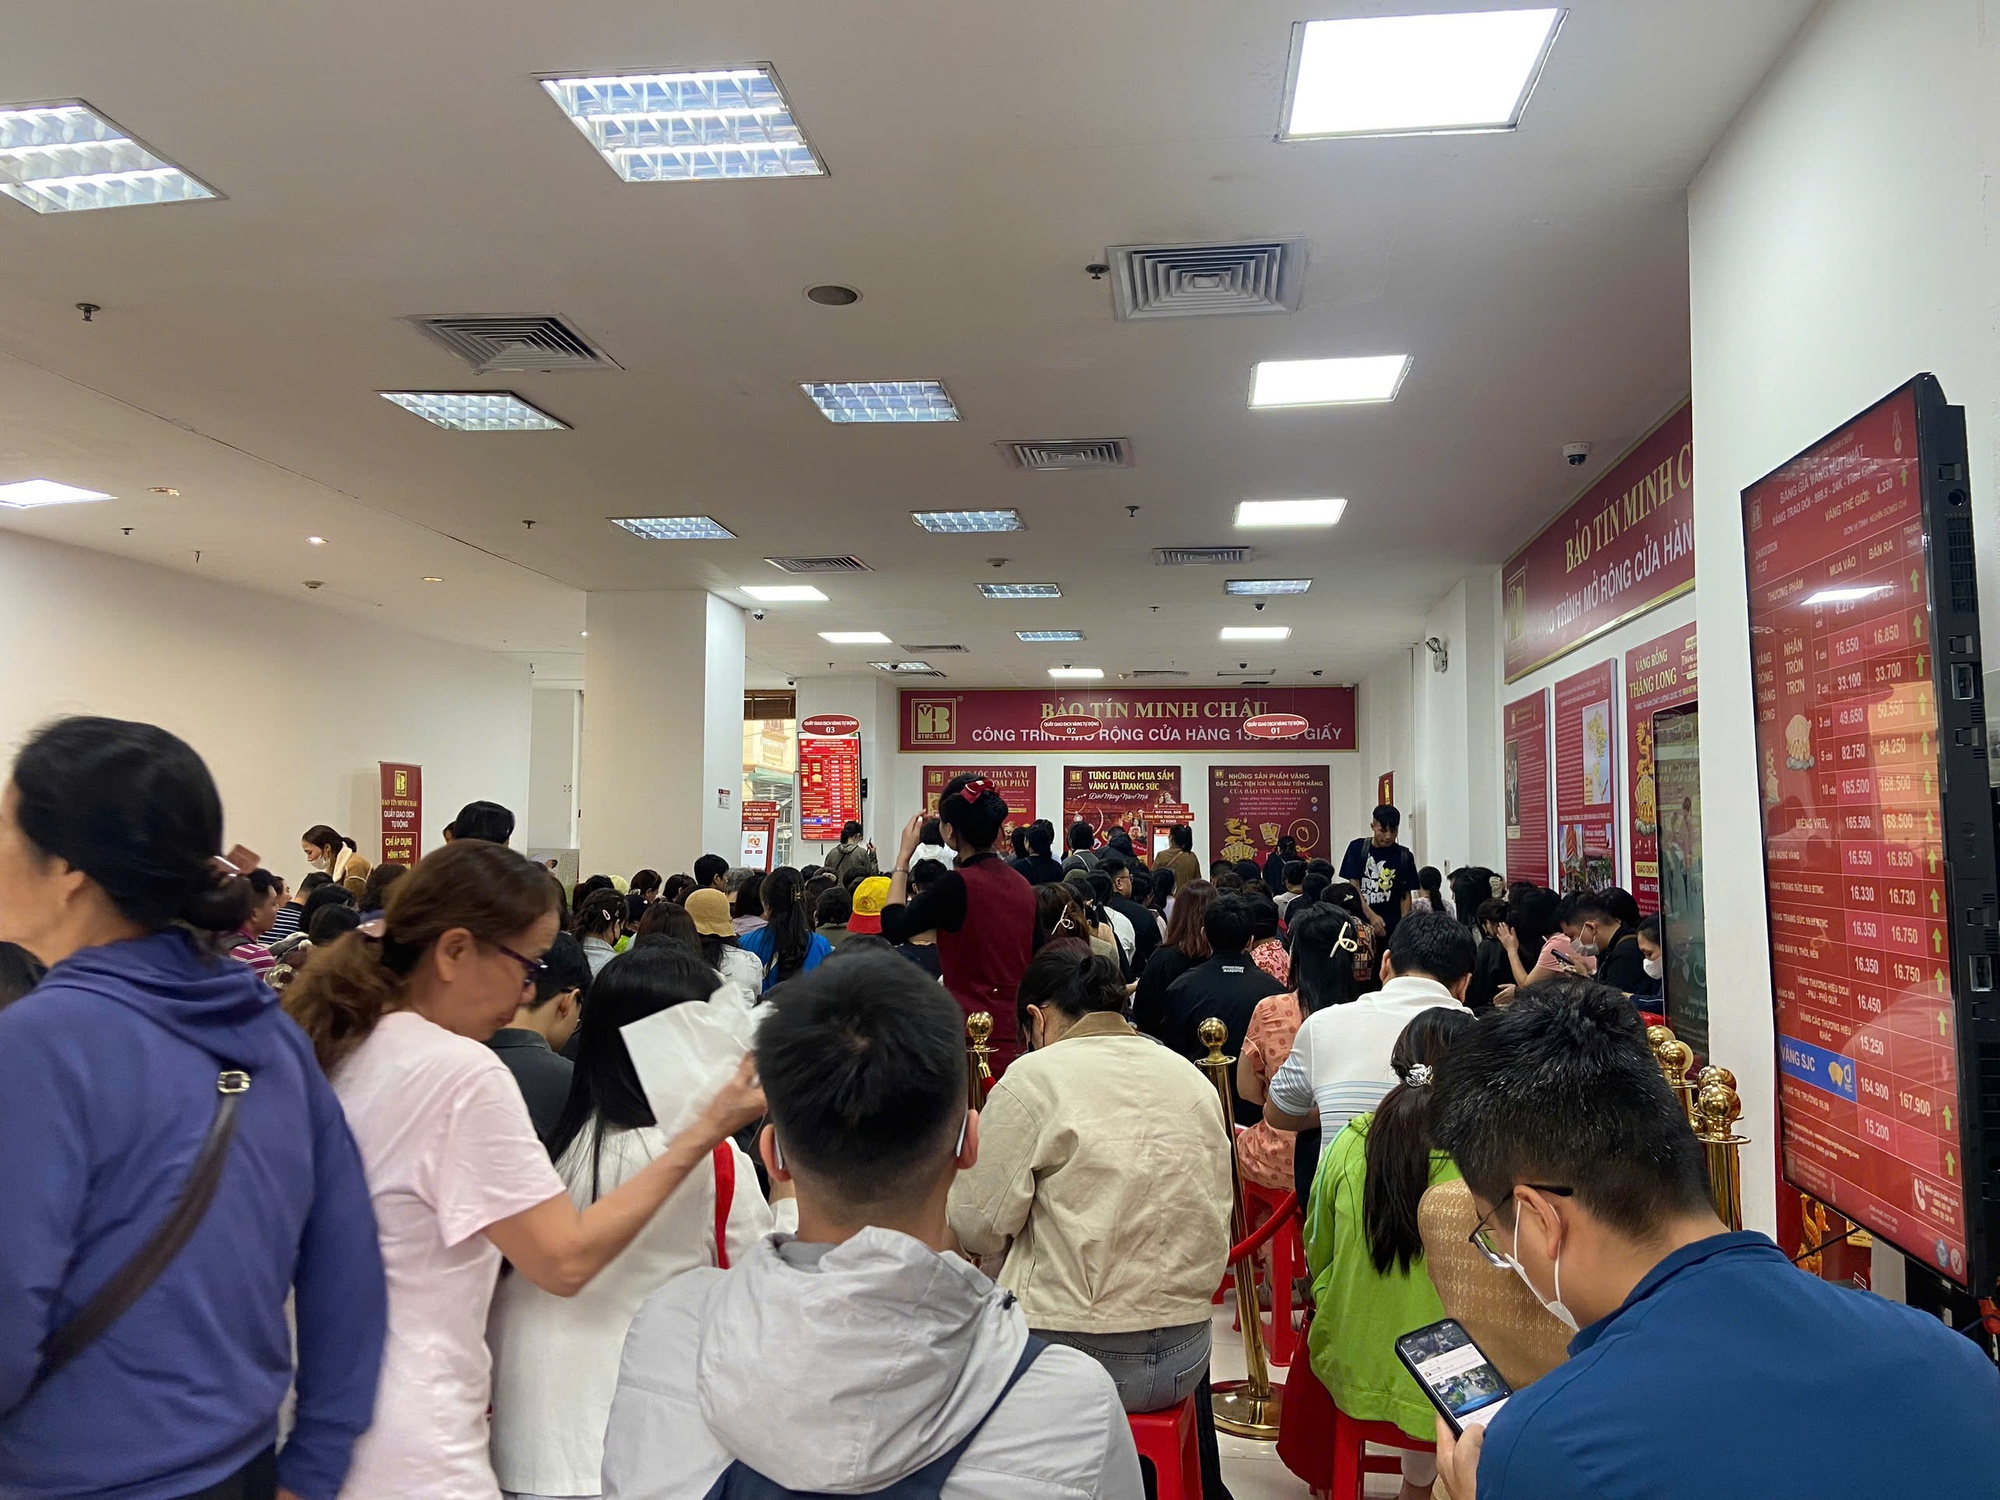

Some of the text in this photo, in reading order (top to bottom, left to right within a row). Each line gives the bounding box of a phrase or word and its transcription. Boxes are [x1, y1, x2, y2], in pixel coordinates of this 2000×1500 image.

[1779, 483, 1798, 504] BẢNG
[1797, 475, 1810, 493] GIÁ
[1825, 505, 1842, 522] VÀNG
[1842, 497, 1855, 515] THẾ
[1876, 478, 1893, 496] 4.330
[1565, 456, 1674, 573] BẢO TÍN MINH
[1786, 504, 1801, 521] TRAO
[1868, 540, 1893, 560] BÁN RA
[1583, 570, 1599, 612] MỞ
[1600, 559, 1632, 604] RỘNG
[1634, 534, 1660, 583] CỬA
[1663, 519, 1696, 566] HÀN
[1829, 556, 1857, 577] MUA VÀO
[1873, 625, 1899, 645] 16.850
[1783, 638, 1803, 656] NHẪN
[1835, 636, 1859, 656] 16.550
[1635, 646, 1668, 672] VÀNG RỒNG
[1815, 651, 1819, 660] 1
[1785, 657, 1804, 675] TRÒN
[1875, 662, 1902, 682] 33.700
[1629, 674, 1654, 699] THĂNG
[1655, 667, 1677, 690] LONG
[1786, 678, 1805, 695] TRƠN
[1817, 684, 1821, 694] 2
[1837, 671, 1862, 691] 33.100
[1041, 697, 1269, 719] BẢO TÍN MINH CHÂU
[1760, 708, 1776, 722] LONG
[1839, 708, 1864, 726] 49.650
[1877, 700, 1904, 719] 50.550
[825, 726, 835, 734] 03
[1066, 727, 1076, 735] 02
[1271, 727, 1280, 735] 01
[1819, 717, 1823, 727] 3
[971, 722, 1343, 744] CÔNG RỘNG CỬA HÀNG GIẤY
[1841, 744, 1866, 760] 82.750
[1879, 737, 1906, 755] 84.250
[1820, 751, 1825, 761] 5
[1015, 770, 1028, 778] TÀI
[1137, 771, 1155, 780] MUA
[1156, 768, 1175, 780] SẮM
[1228, 772, 1253, 780] NHỮNG
[1254, 771, 1267, 779] SẢN
[1269, 771, 1290, 779] PHẨM
[1088, 781, 1109, 790] VÀNG
[1109, 781, 1120, 790] VÀ
[1120, 782, 1145, 790] TRANG
[1145, 781, 1160, 790] SỨC
[1821, 785, 1829, 795] 10
[1842, 778, 1870, 795] 165.500
[1880, 777, 1911, 792] 168.500
[1813, 818, 1829, 829] VRTL
[1845, 816, 1871, 829] 165.500
[1882, 813, 1913, 829] 168.500
[1848, 849, 1872, 865] 16.550
[1886, 851, 1913, 867] 16.850
[1850, 885, 1874, 902] 16.330
[1889, 888, 1916, 905] 16.730
[1852, 919, 1877, 938] 16.350
[1891, 924, 1918, 944] 16.750
[1854, 955, 1879, 975] 16.350
[1893, 962, 1921, 983] 16.750
[1857, 993, 1882, 1013] 16.450
[1859, 1035, 1884, 1056] 15.250
[1780, 1044, 1816, 1073] VÀNG SJC
[1860, 1076, 1889, 1101] 164.900
[1899, 1091, 1931, 1118] 167.900
[1864, 1118, 1890, 1141] 15.200
